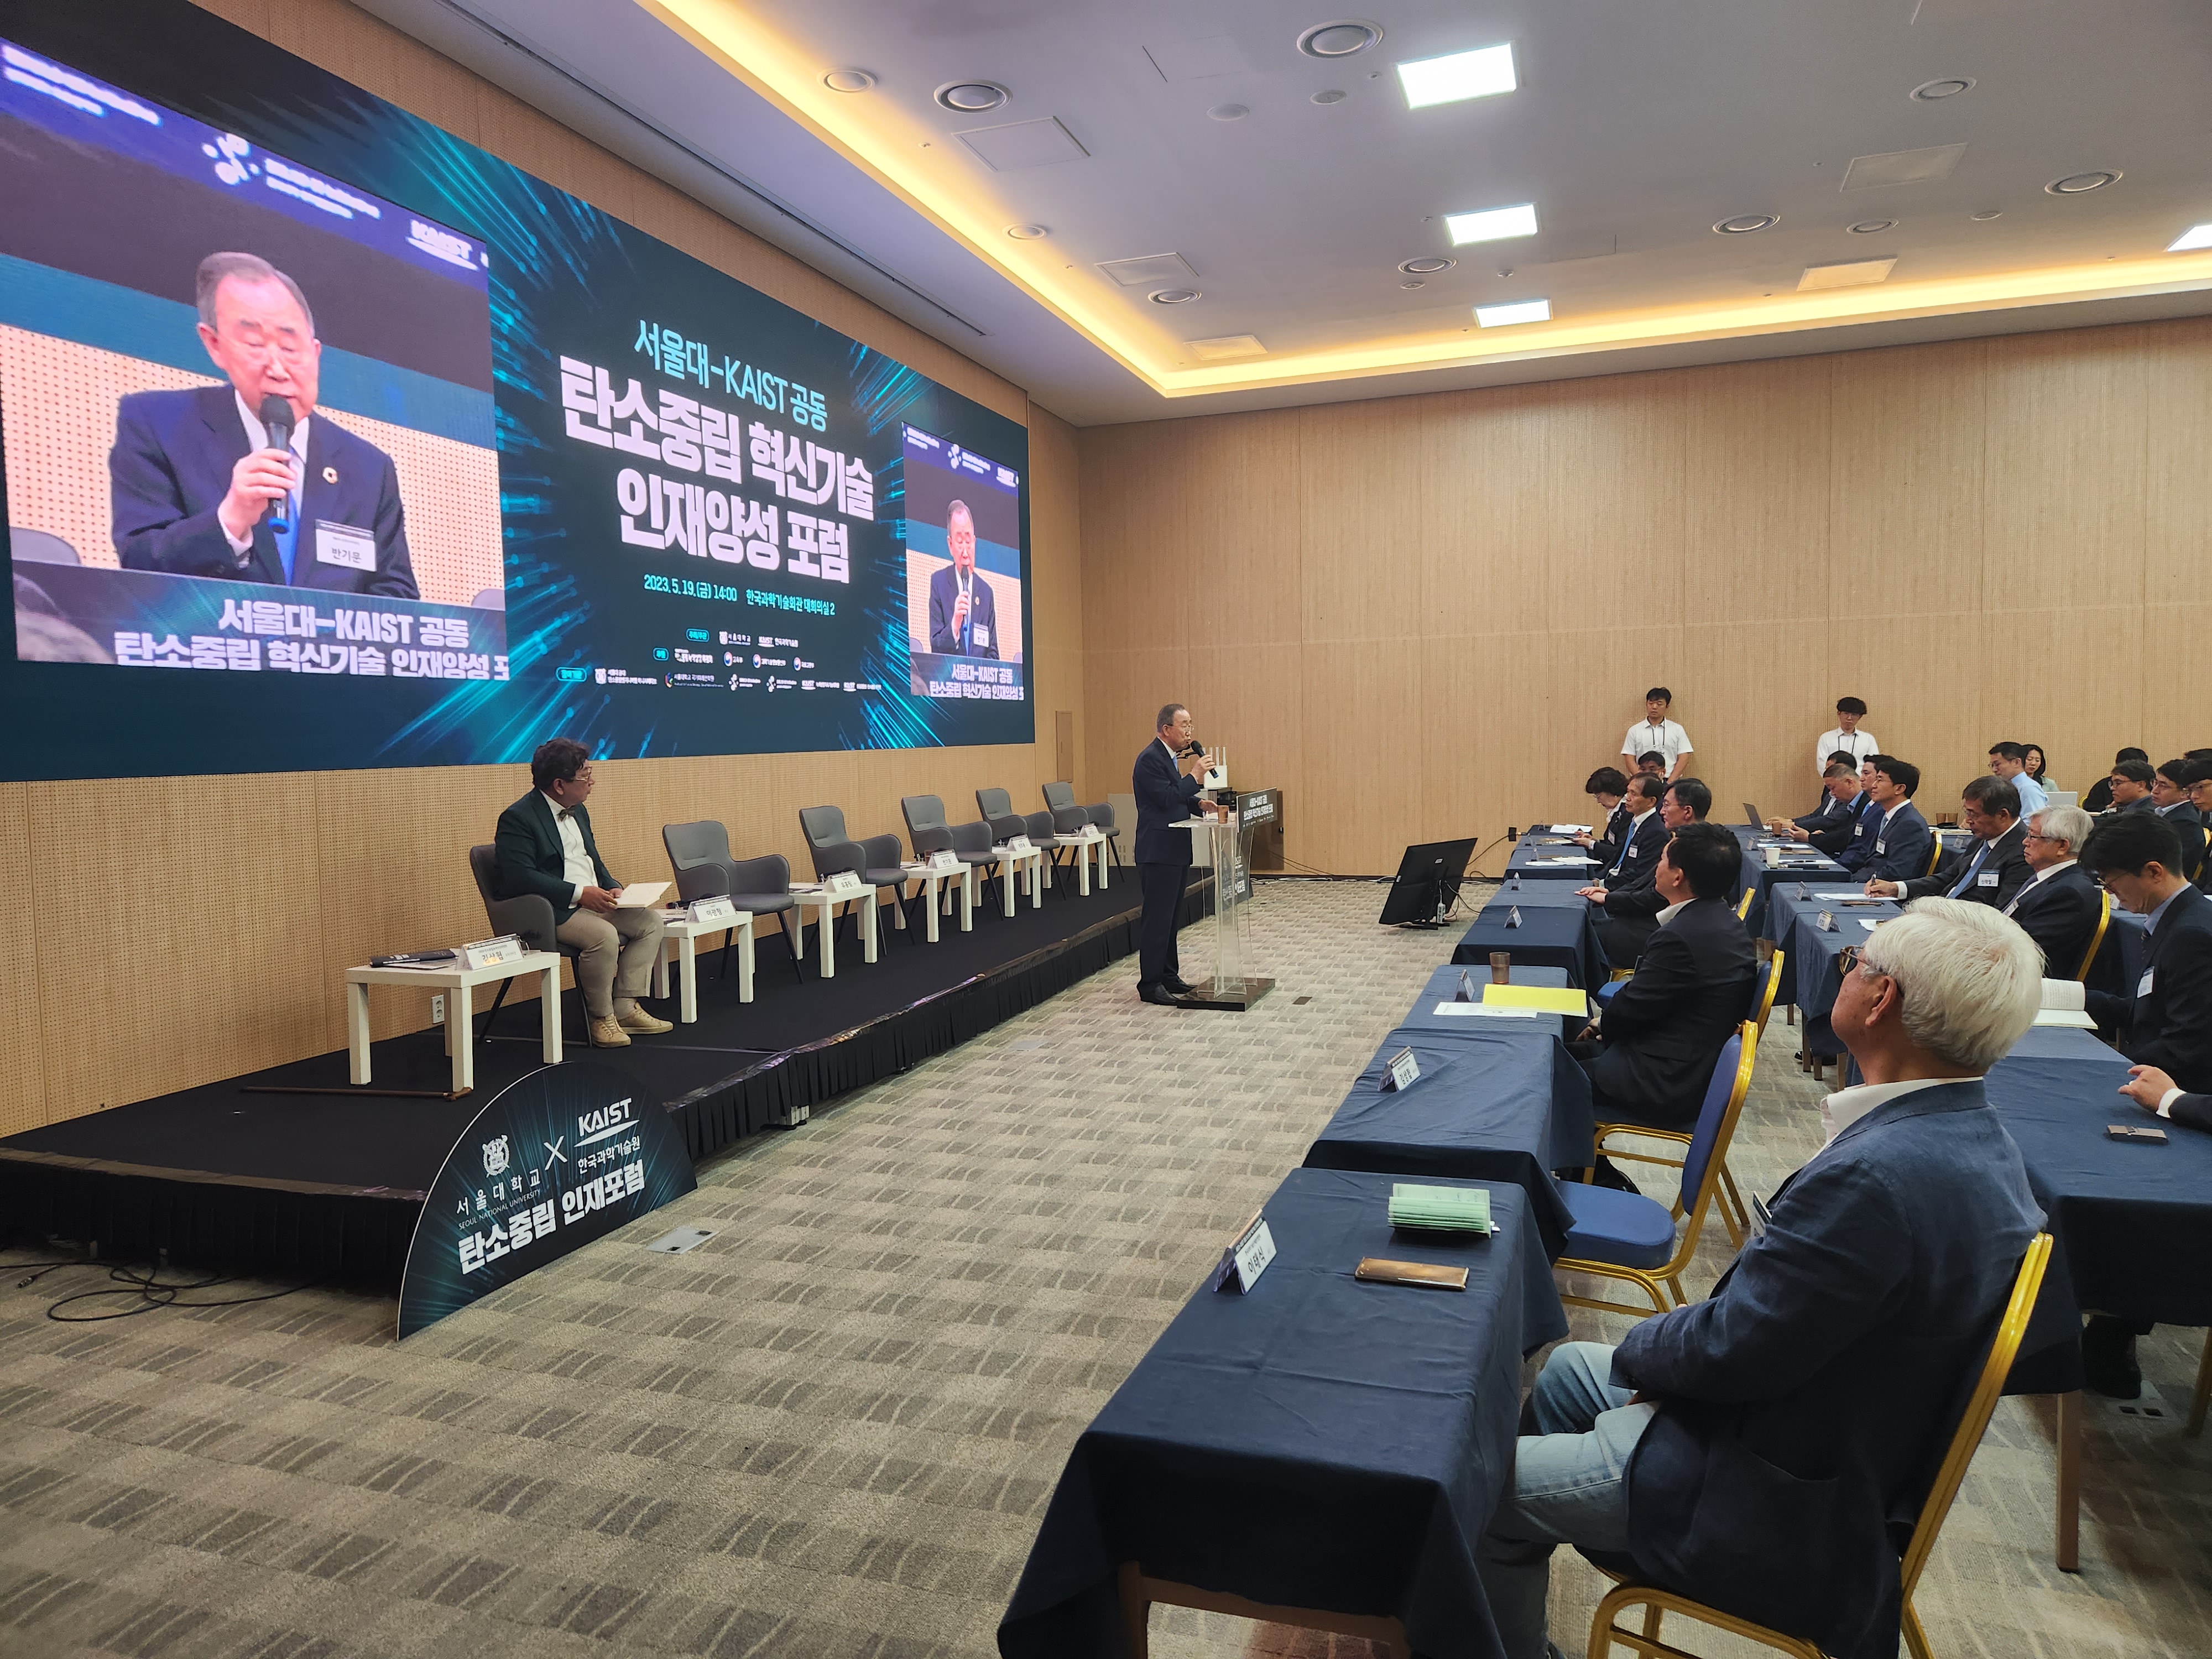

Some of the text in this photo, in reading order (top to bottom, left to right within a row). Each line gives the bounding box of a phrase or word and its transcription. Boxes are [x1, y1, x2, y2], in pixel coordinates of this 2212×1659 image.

[634, 320, 828, 432] 서울대-KAIST 공동
[560, 355, 874, 520] 탄소중립 혁신기술
[617, 468, 850, 584] 인재양성 포럼
[331, 547, 362, 564] 반기문
[713, 584, 737, 602] 14:00
[746, 588, 803, 612] 한국과학기술회관
[219, 598, 469, 648] 서울대-KAIST 공동
[114, 631, 261, 671] 탄소중립
[269, 640, 386, 676] 혁신기술
[392, 648, 489, 680] 인재양성
[952, 664, 1013, 684] 서울대-KAIST 공동
[930, 681, 962, 698] 탄소중립
[963, 682, 991, 699] 혁신기술
[992, 685, 1018, 701] 인재양성
[578, 1098, 632, 1137] KAIST
[577, 1135, 640, 1175] 한국과학기술원
[458, 1188, 541, 1230] SEOUL NATIONAL UNIVERSITY
[458, 1159, 645, 1275] 탄소중립 인재포럼
